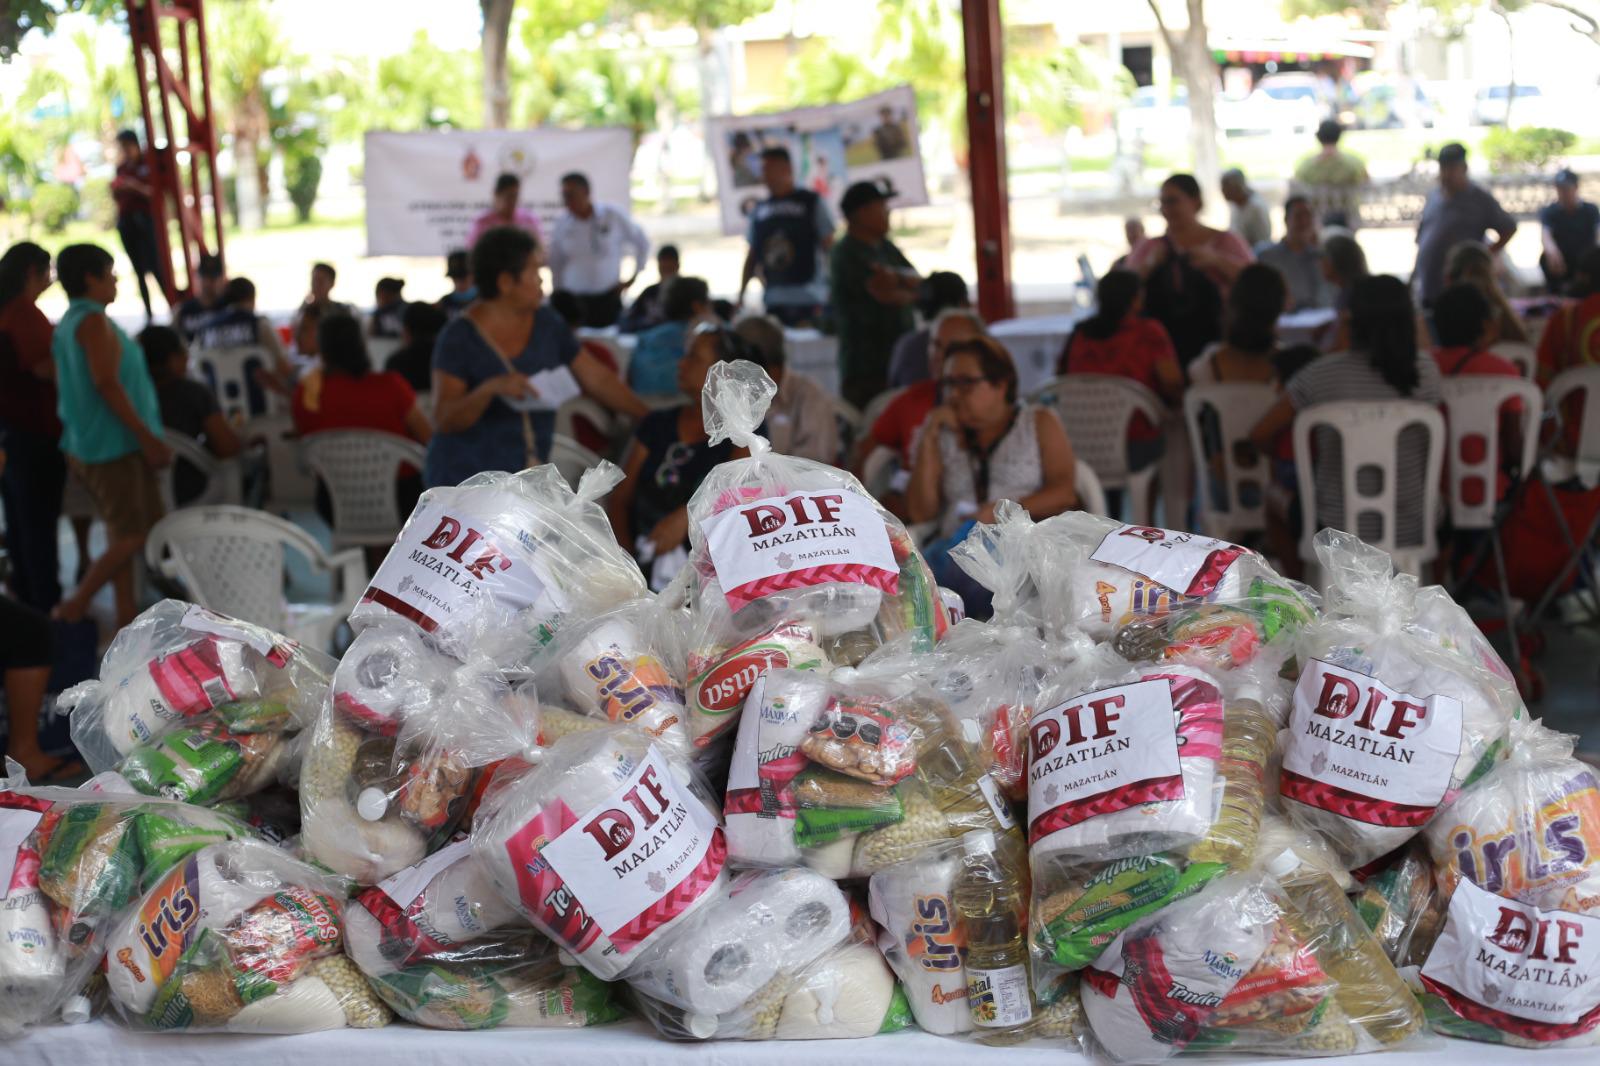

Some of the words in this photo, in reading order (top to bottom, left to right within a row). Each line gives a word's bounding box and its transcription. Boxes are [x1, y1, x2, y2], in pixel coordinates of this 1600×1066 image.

[740, 495, 843, 538] DIF
[752, 524, 856, 552] MAZATLÁN
[421, 515, 513, 580] DIF
[798, 547, 851, 562] MAZATLÁN
[1314, 672, 1427, 740] DIF
[1030, 694, 1126, 767] DIF
[1306, 720, 1415, 764] MAZATLÁN
[1031, 737, 1131, 785] MAZATLÁN
[1064, 769, 1118, 793] MAZATLÁN
[1330, 763, 1389, 787] MAZATLÁN
[583, 764, 670, 862] DIF
[613, 803, 688, 880] MAZATLÁN
[666, 837, 700, 874] MAZATLÁN
[139, 886, 197, 958] iris
[913, 897, 961, 972] iris
[1485, 906, 1584, 965] DIF
[1476, 948, 1588, 989] MAZATLÁN
[1506, 995, 1566, 1013] MAZATLÁN
